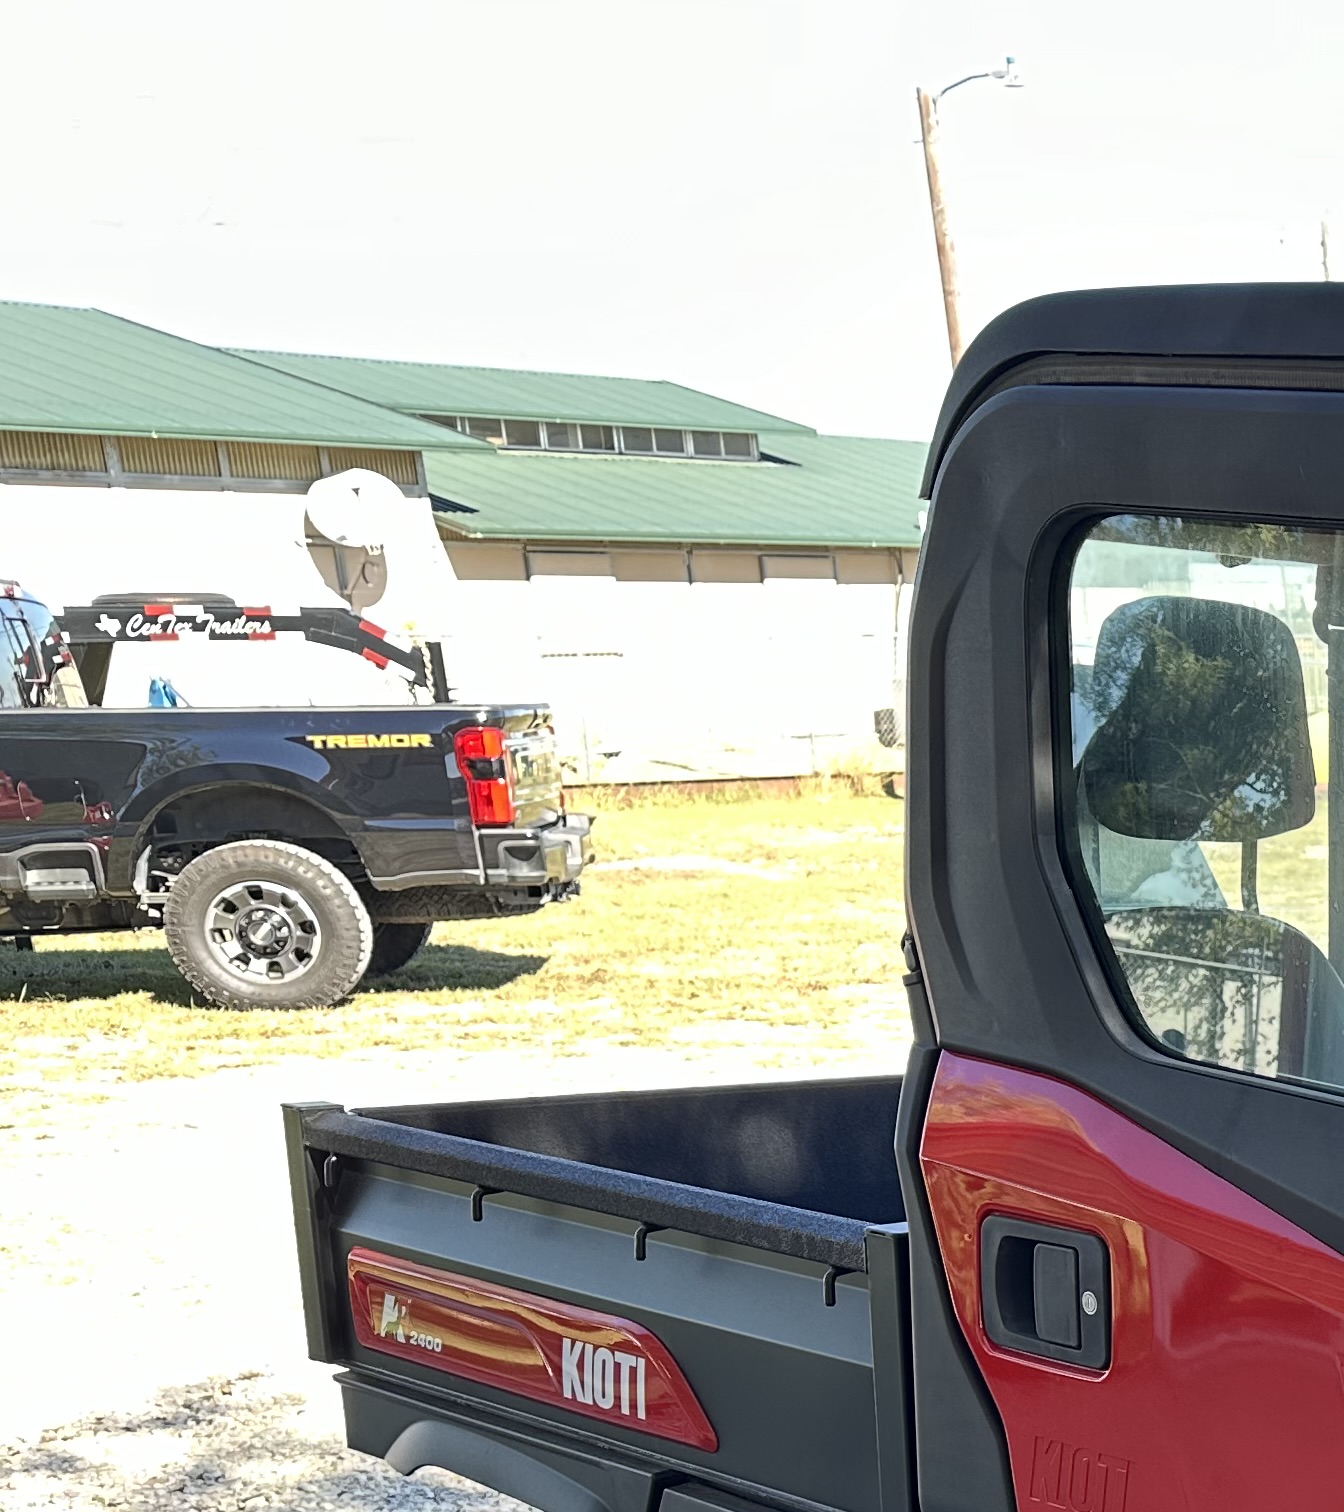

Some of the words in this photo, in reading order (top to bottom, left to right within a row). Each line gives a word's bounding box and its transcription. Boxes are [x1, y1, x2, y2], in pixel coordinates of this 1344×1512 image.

[125, 613, 193, 638] CenTex
[195, 613, 272, 635] Trailers
[305, 733, 434, 749] TREMOR
[409, 1330, 443, 1353] 2400
[562, 1337, 646, 1421] KIOTI
